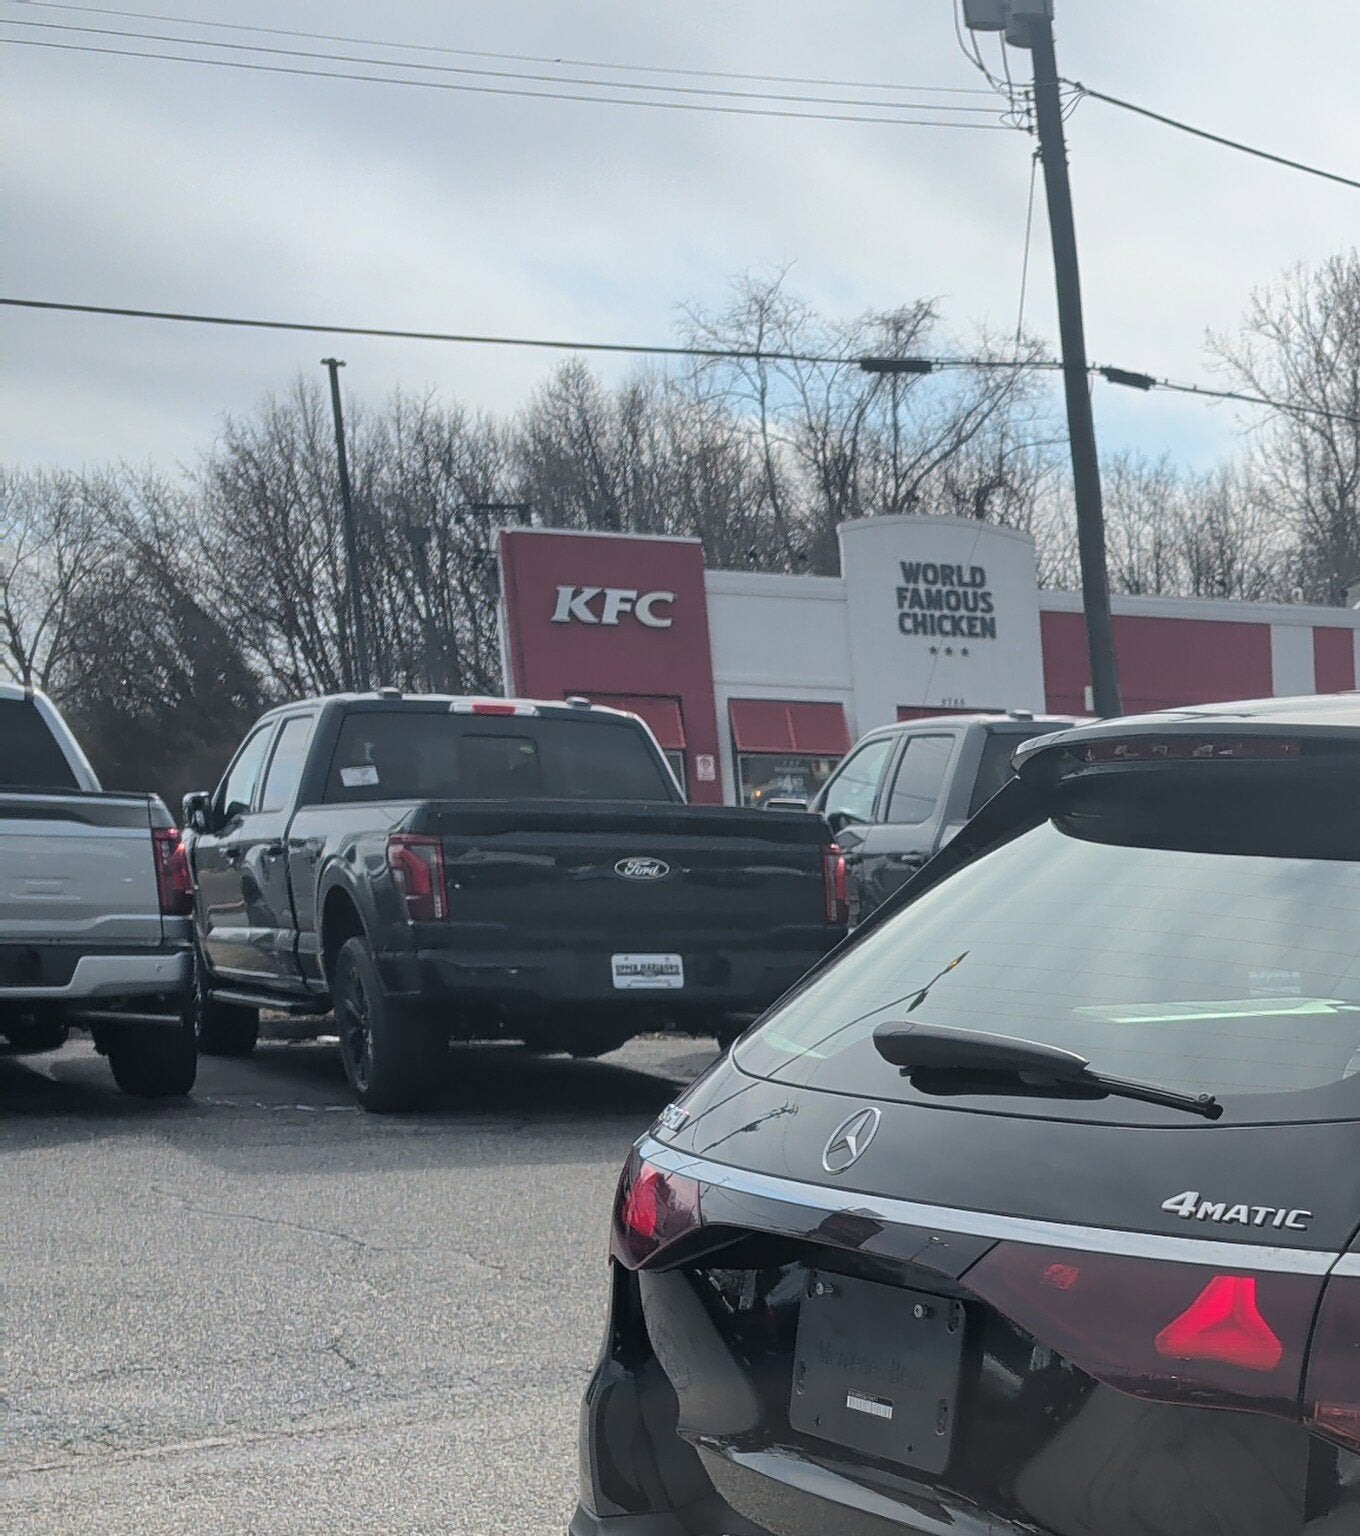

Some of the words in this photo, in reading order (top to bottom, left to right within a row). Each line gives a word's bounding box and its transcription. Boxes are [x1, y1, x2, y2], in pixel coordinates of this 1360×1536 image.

[900, 562, 986, 589] WORLD
[550, 585, 675, 628] KFC
[896, 587, 995, 614] FAMOUS
[898, 612, 997, 640] CHICKEN
[1161, 1190, 1314, 1231] 4MATIC
